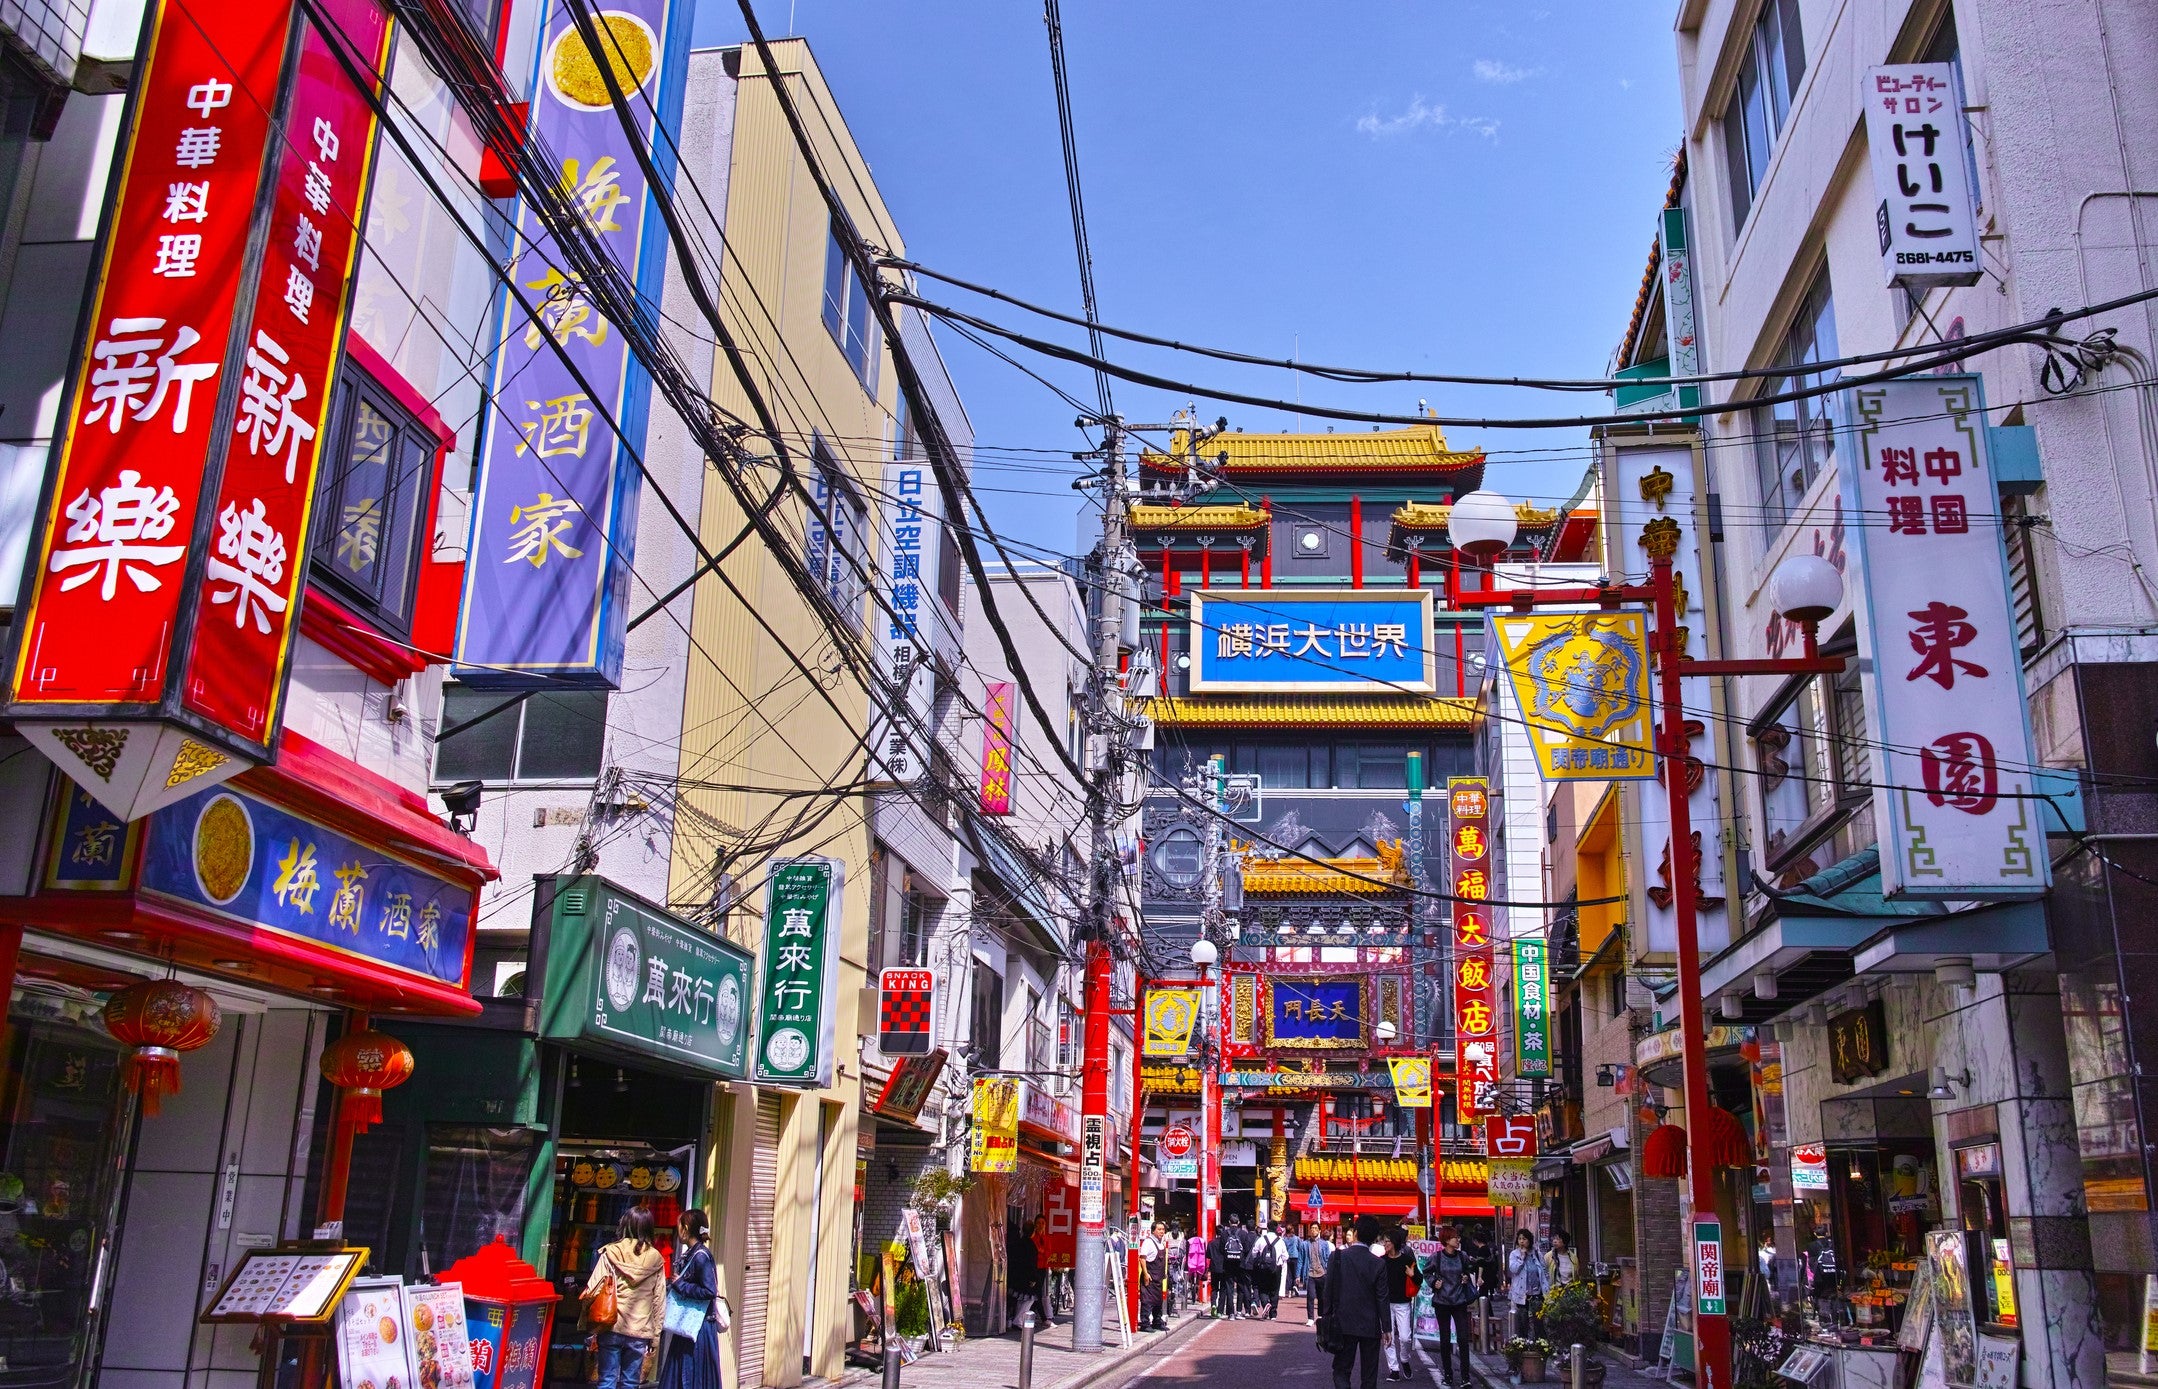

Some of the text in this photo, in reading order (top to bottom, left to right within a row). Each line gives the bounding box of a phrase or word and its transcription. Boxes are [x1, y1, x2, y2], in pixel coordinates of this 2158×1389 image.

[1876, 75, 1946, 92] ビューティー
[1883, 97, 1943, 114] サロン
[153, 77, 234, 279] 中華料理
[283, 116, 341, 326] 中華料理
[1892, 124, 1953, 239] けいこ
[50, 317, 220, 601] 新樂
[208, 328, 316, 636] 新樂
[1881, 447, 1927, 535] 料理
[1924, 446, 1969, 534] 中国
[890, 470, 922, 640] 日立空調機器
[1217, 623, 1409, 658] 横浜大世界
[1905, 601, 1998, 816] 東園
[273, 836, 441, 949] 梅蘭酒家
[1456, 826, 1490, 1034] 萬福大飯店
[889, 980, 929, 989] KING
[1521, 944, 1544, 1051] 中国食材・茶
[1495, 1119, 1533, 1154] 占
[1700, 1244, 1719, 1297] 関帝廟
